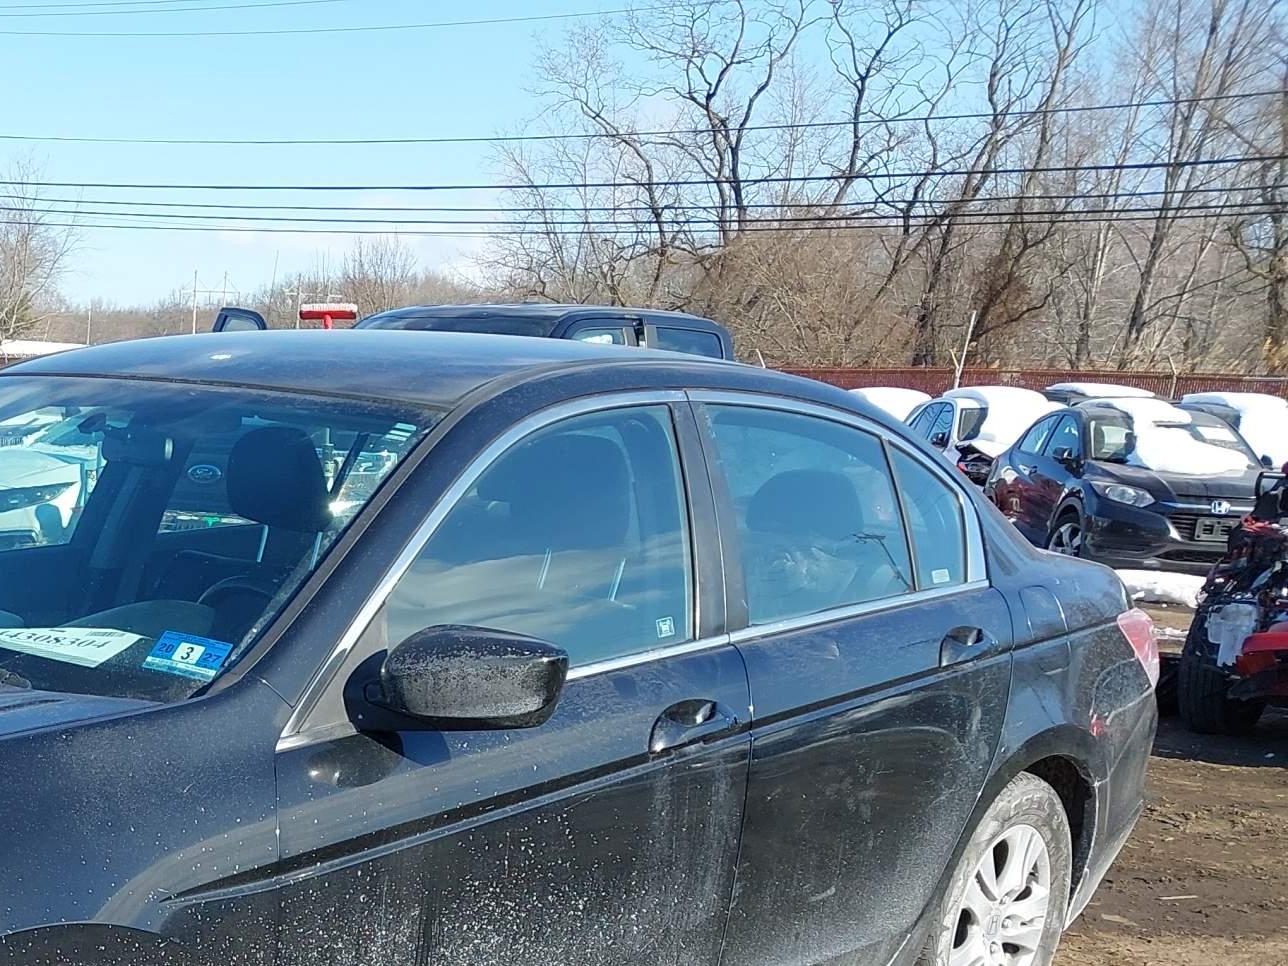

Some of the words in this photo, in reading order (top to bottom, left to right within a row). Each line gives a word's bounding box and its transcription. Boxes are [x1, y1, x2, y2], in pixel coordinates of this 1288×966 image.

[158, 642, 175, 654] 20
[180, 646, 195, 660] 3
[202, 652, 222, 663] 27
